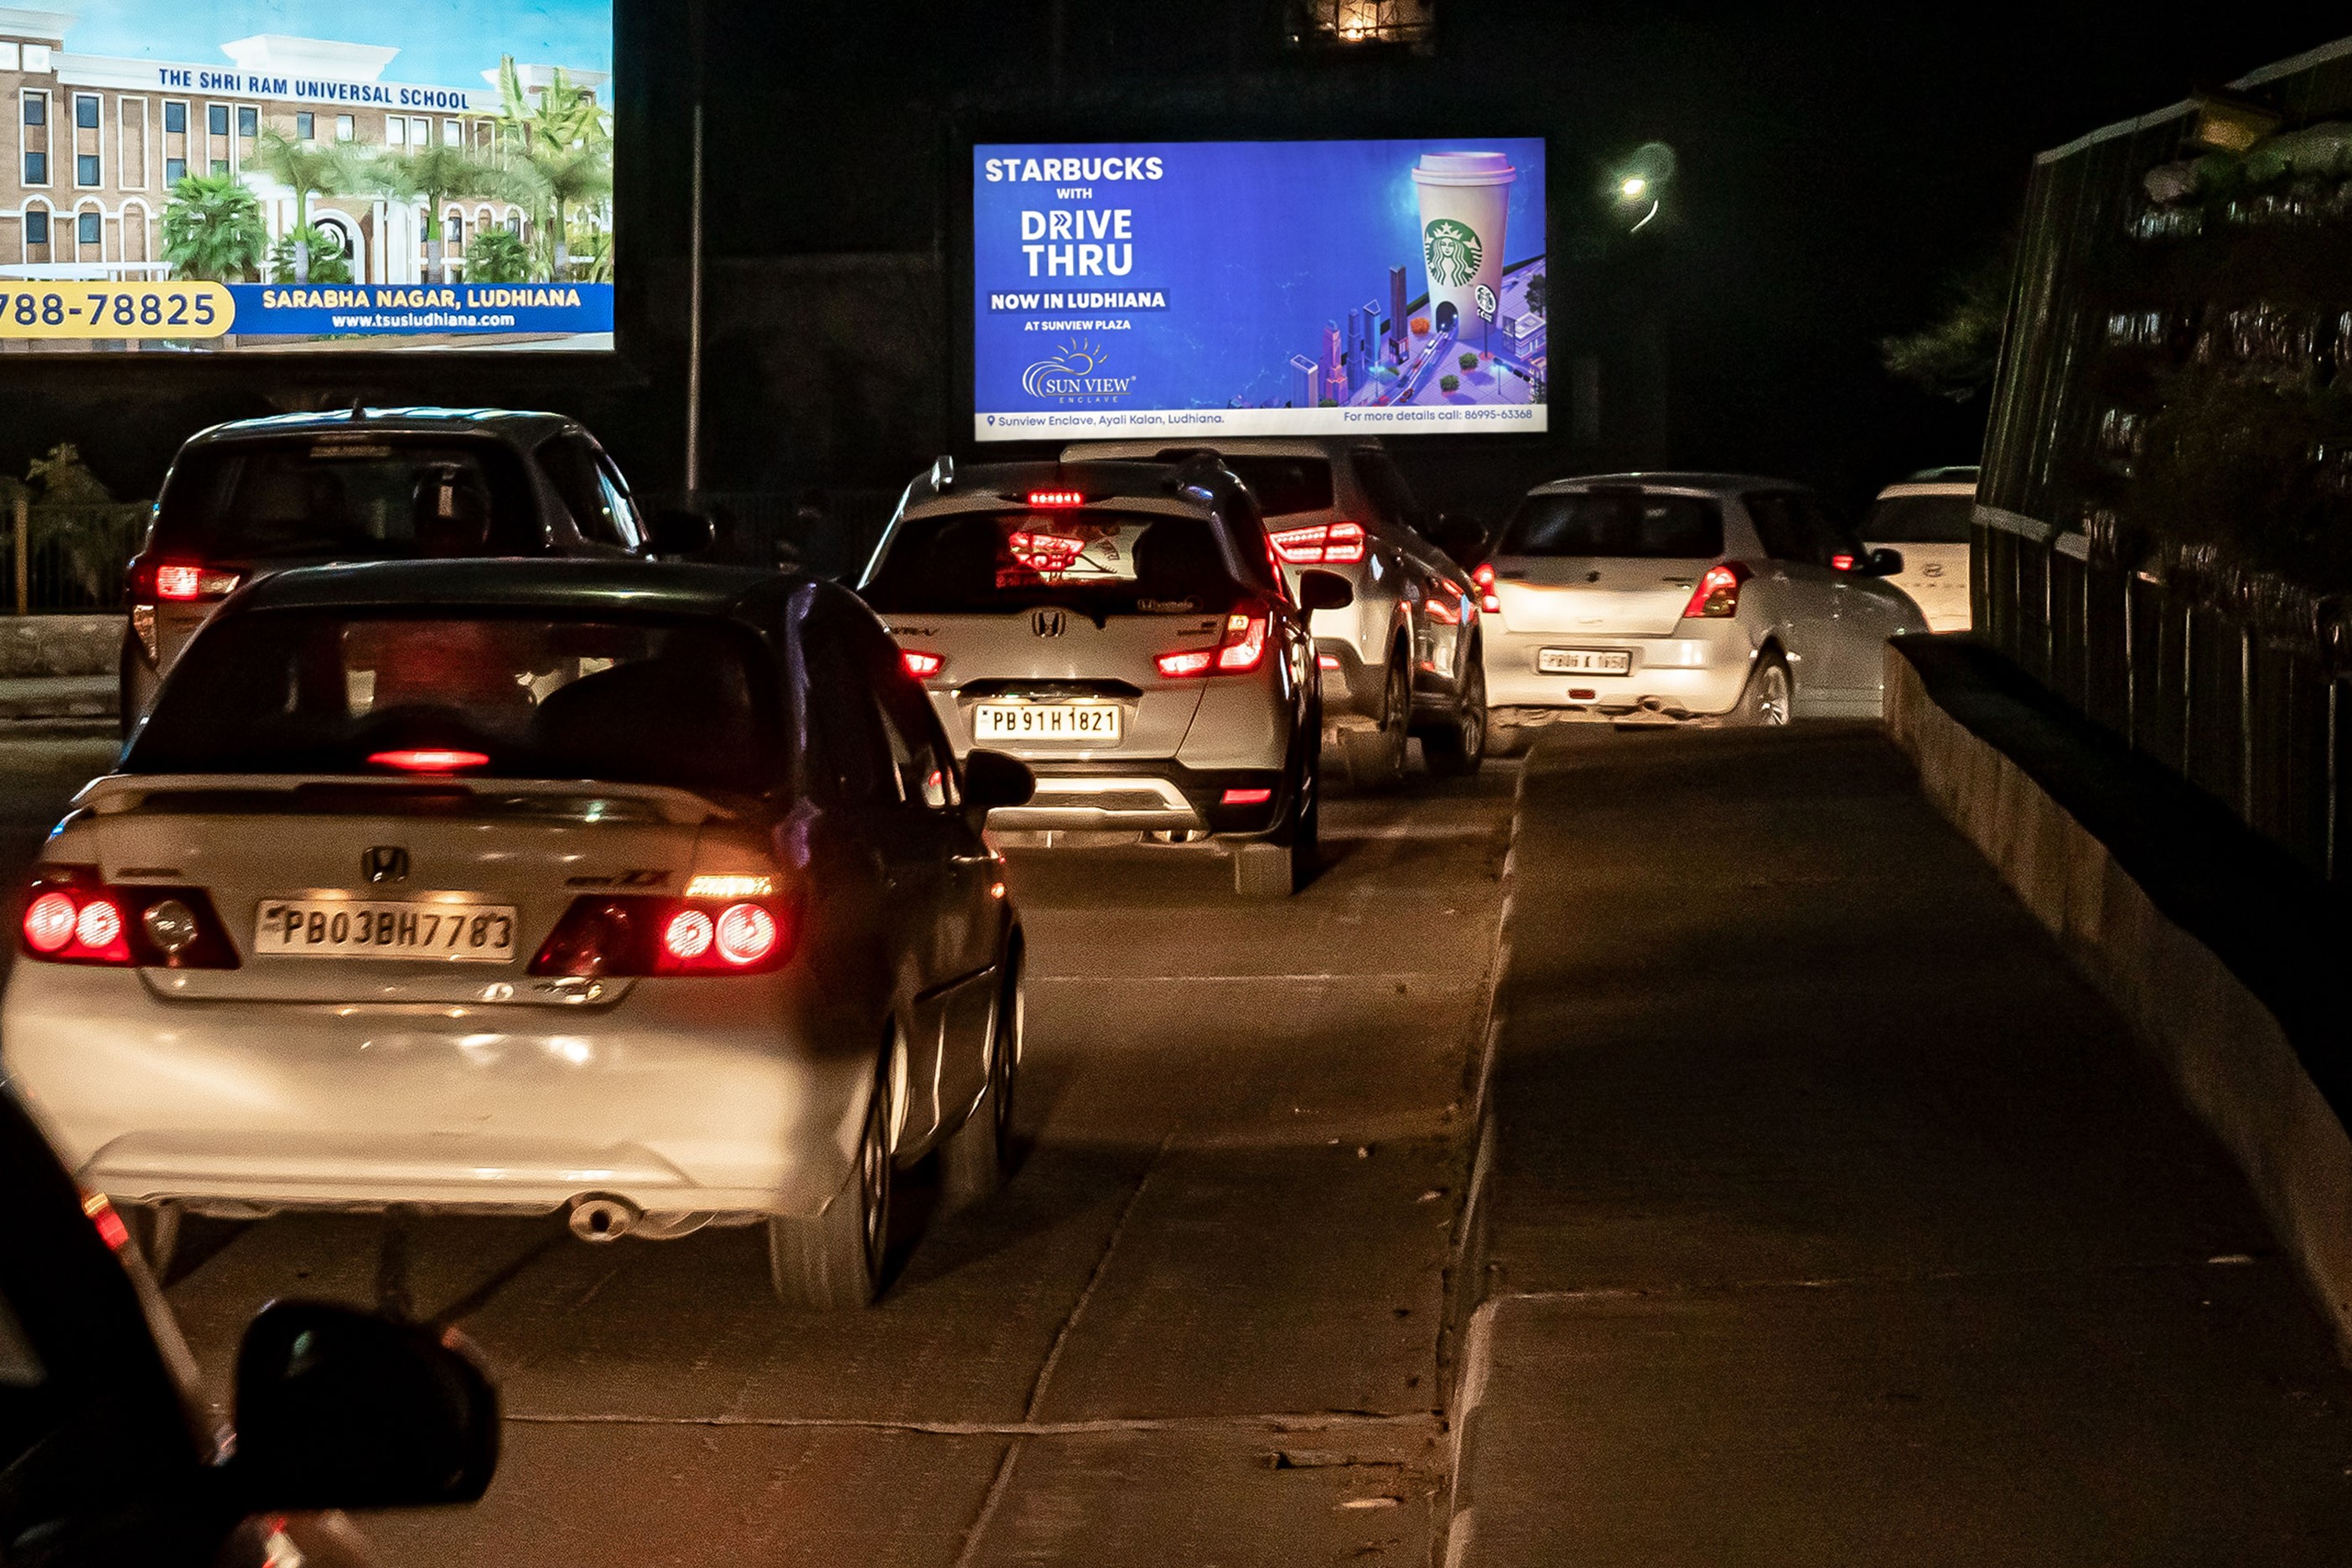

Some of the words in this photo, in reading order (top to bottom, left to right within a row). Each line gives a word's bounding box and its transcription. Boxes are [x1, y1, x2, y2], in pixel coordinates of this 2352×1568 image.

[159, 69, 191, 86] THE
[199, 72, 241, 91] SHRI
[249, 76, 287, 95] RAM
[296, 80, 392, 104] UNIVERSAL
[400, 88, 469, 110] SCHOOL
[985, 157, 1163, 182] STARBUCKS
[1056, 188, 1092, 199] WITH
[1021, 210, 1132, 241] DRIVE
[1022, 243, 1132, 277] THRU
[262, 290, 370, 308] SARABHA
[376, 290, 462, 311] NAGAR,
[468, 289, 581, 308] LUDHIANA
[991, 294, 1039, 309] NOW
[1044, 294, 1064, 309] IN
[1067, 292, 1166, 308] LUDHIANA
[332, 313, 515, 328] www.tsusludhiana.com
[1024, 321, 1039, 331] AT
[1041, 320, 1094, 330] SUNVIEW
[1095, 320, 1132, 329] PLAZA
[1046, 380, 1080, 393] SUN
[998, 417, 1046, 427] Sunview
[1048, 416, 1096, 427] Enclave,
[1098, 414, 1127, 427] Ayali
[1129, 414, 1166, 425] Kalan,
[1168, 413, 1225, 424] Ludhiana.
[1344, 411, 1361, 422] For
[1396, 411, 1436, 421] details
[1438, 410, 1462, 420] call:
[1464, 409, 1533, 420] 86995-63368
